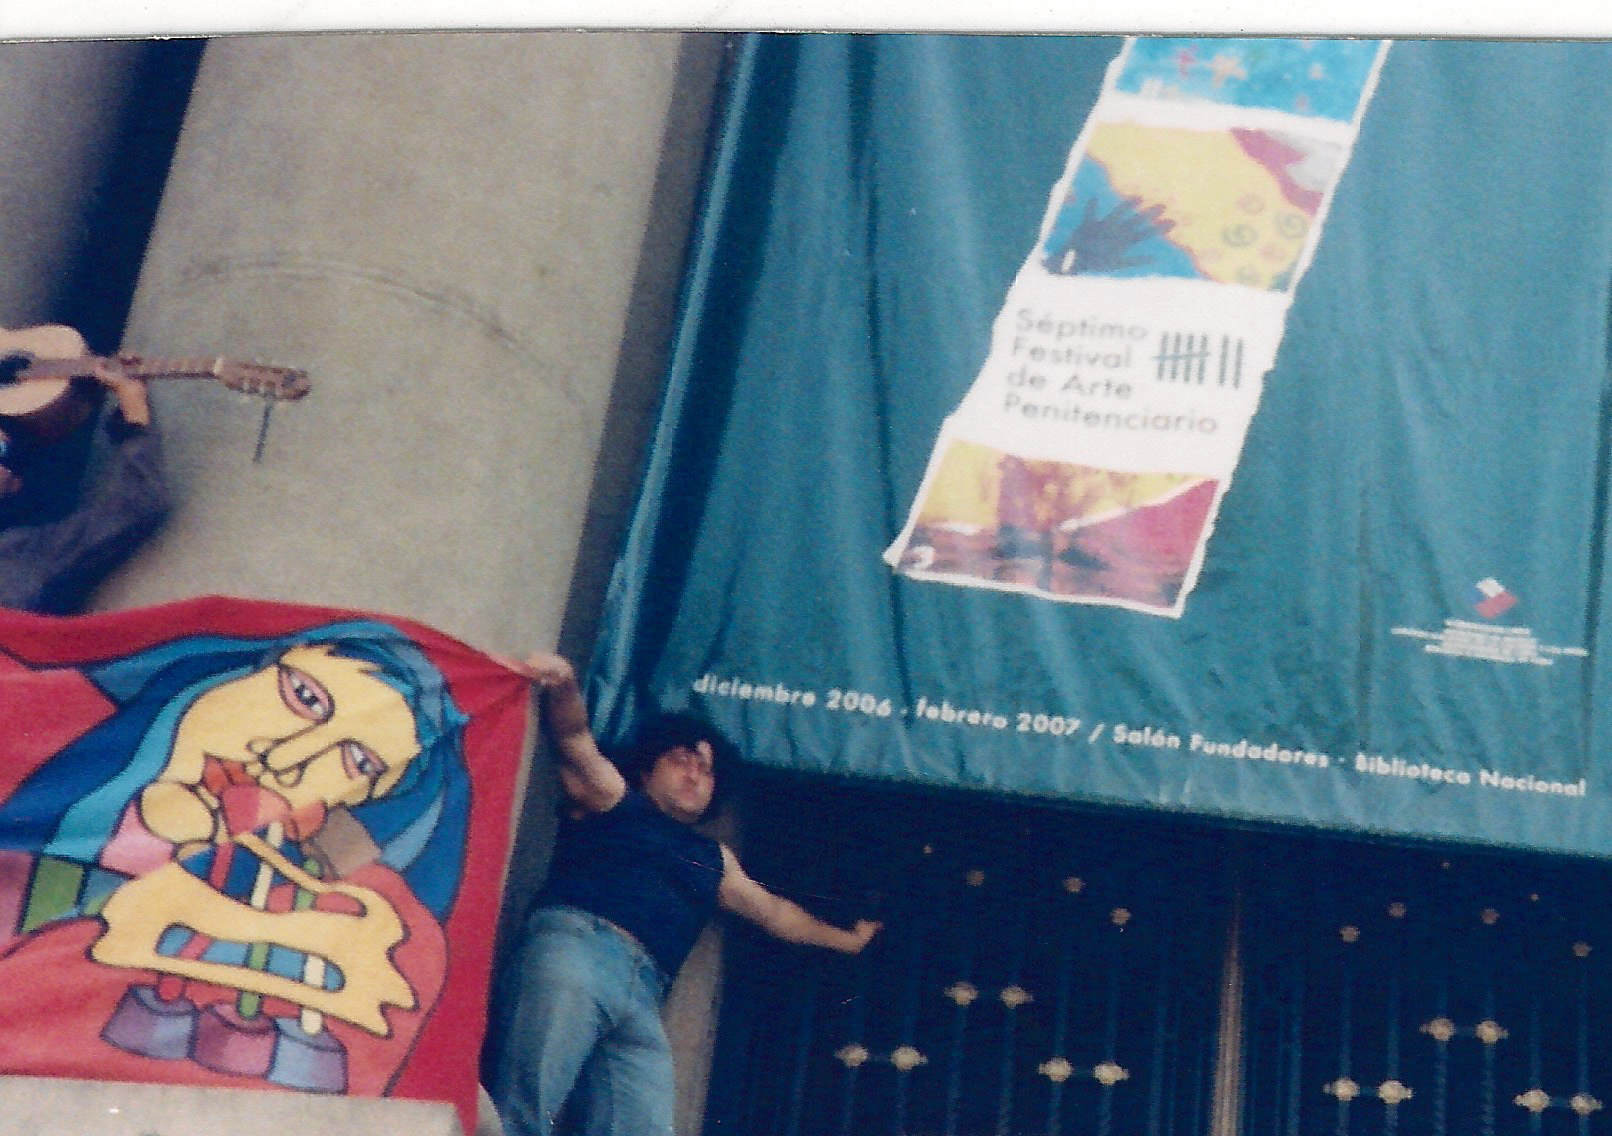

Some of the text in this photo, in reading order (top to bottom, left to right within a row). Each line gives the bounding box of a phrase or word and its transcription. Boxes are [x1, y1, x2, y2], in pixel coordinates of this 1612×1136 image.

[1016, 308, 1148, 341] Séptimo
[1013, 336, 1132, 369] Festival
[1006, 366, 1133, 399] de Arte
[1004, 392, 1218, 434] Penitenciario
[692, 672, 816, 707] diciembre
[827, 688, 892, 718] 2006
[916, 696, 1008, 730] febrero
[1016, 712, 1082, 736] 2007
[1089, 722, 1104, 744] /
[1114, 724, 1181, 748] Salón
[1190, 732, 1329, 767] Fundadores
[1355, 752, 1471, 785] Biblioteca
[1480, 769, 1587, 797] Nacional
